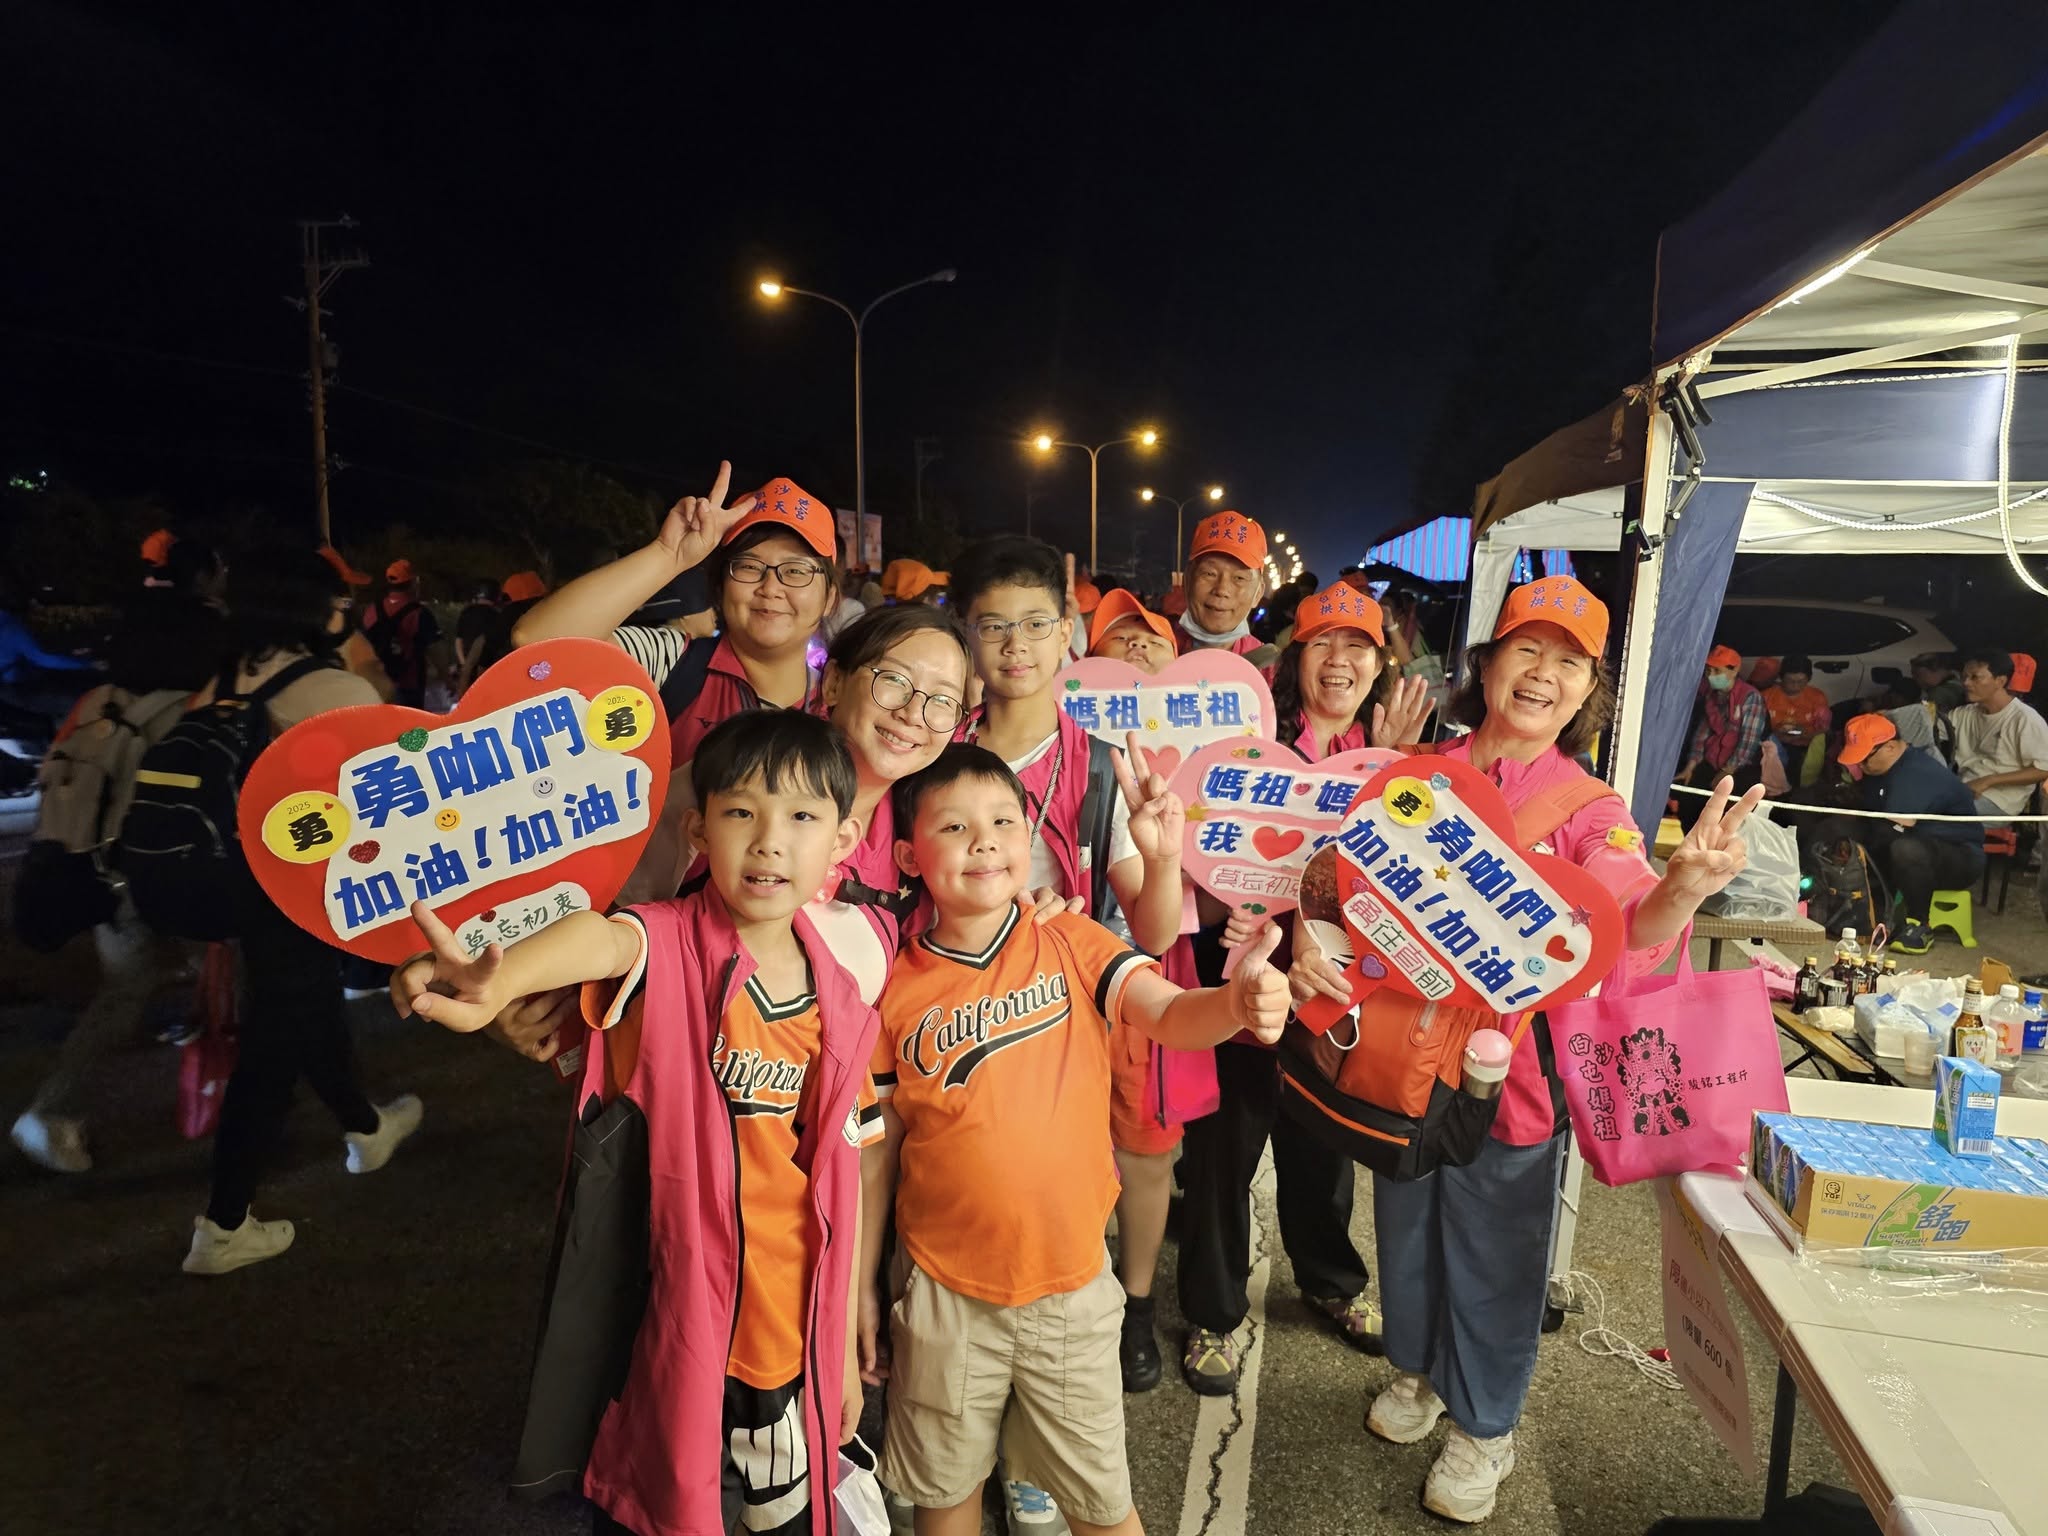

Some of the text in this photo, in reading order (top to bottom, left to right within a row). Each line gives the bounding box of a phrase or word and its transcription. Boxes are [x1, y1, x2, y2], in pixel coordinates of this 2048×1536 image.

[607, 696, 627, 706] 2025
[1064, 691, 1243, 731] 媽祖 媽祖
[605, 706, 637, 742] 勇
[351, 695, 586, 828] 勇咖們
[1204, 766, 1293, 807] 媽祖
[1391, 790, 1422, 818] 勇
[287, 801, 311, 815] 2025
[288, 811, 333, 852] 勇
[1199, 821, 1242, 854] 我
[1424, 814, 1557, 939] 勇咖們
[1348, 894, 1453, 999] 勇往直前
[903, 972, 1072, 1076] California
[1914, 1203, 1971, 1242] 舒跑
[1704, 1338, 1722, 1369] 600
